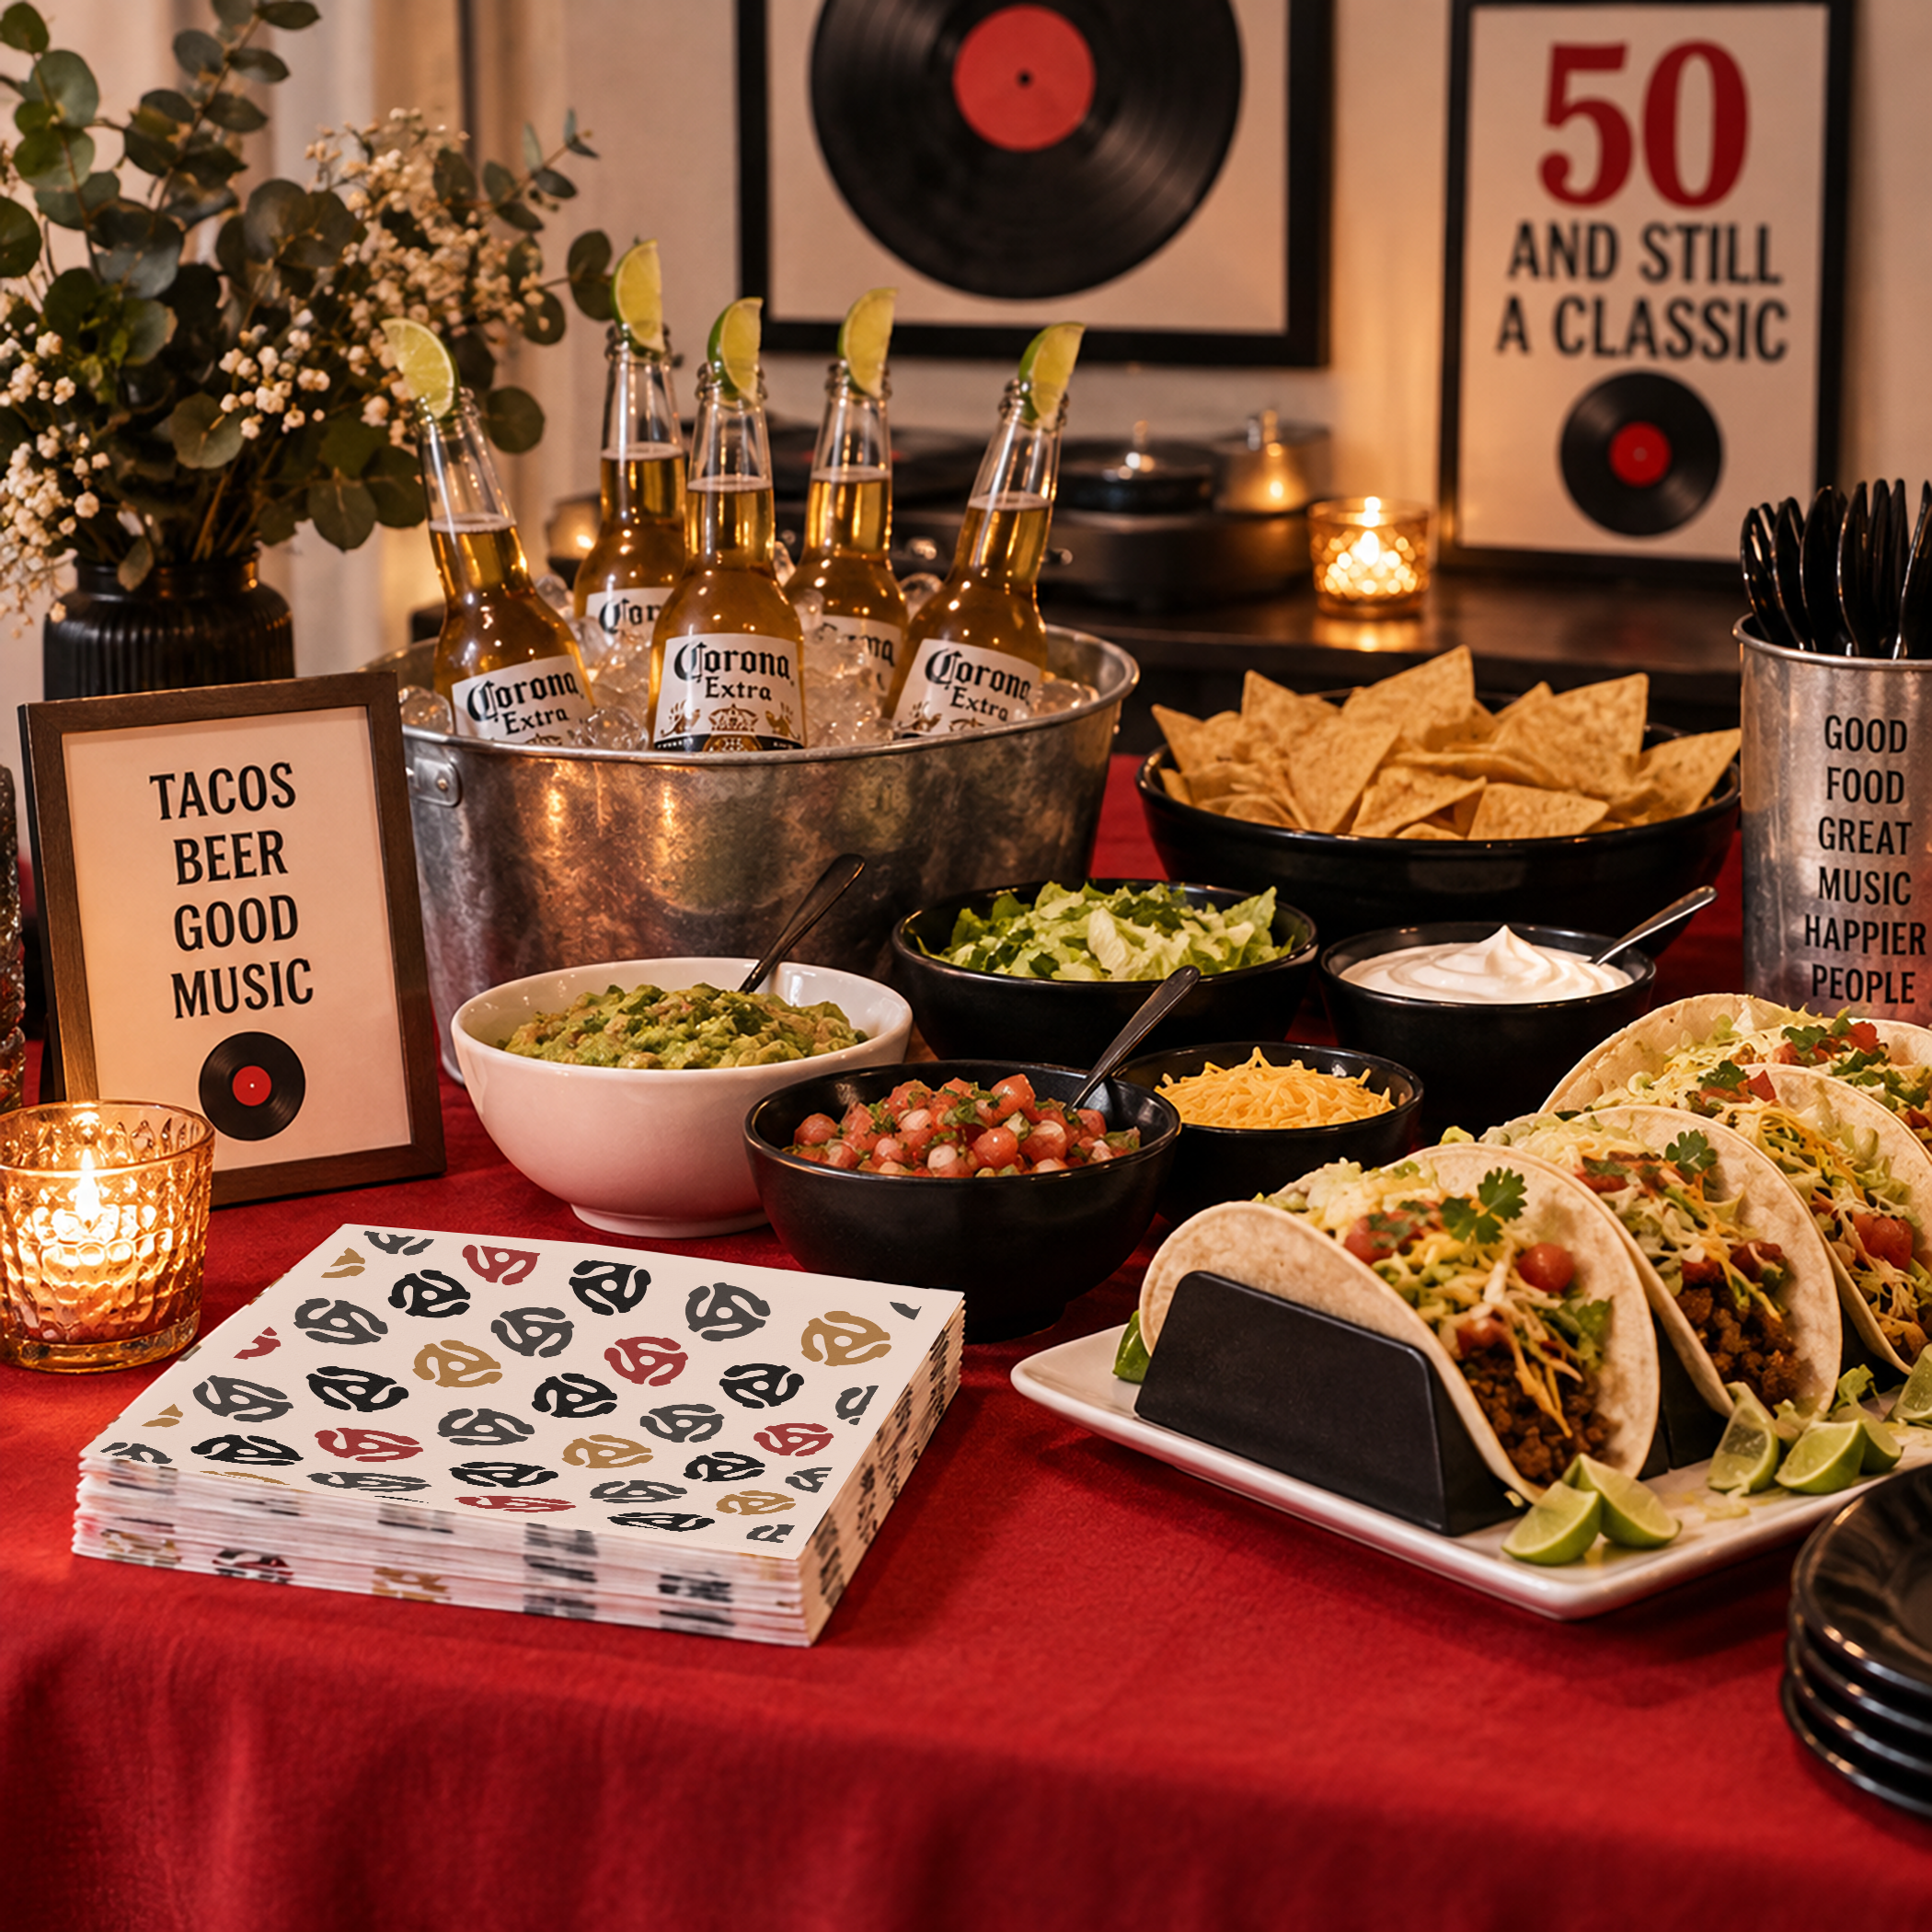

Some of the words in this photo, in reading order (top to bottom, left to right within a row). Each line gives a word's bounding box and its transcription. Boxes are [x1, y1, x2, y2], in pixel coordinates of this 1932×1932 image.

[1537, 39, 1751, 211] 50
[1506, 220, 1620, 282] AND
[1639, 222, 1784, 285] STILL
[1496, 294, 1531, 357] A
[1553, 295, 1788, 363] CLASSIC
[599, 598, 662, 635] Cor
[674, 642, 793, 684] Corona
[925, 648, 1032, 706] Corona
[467, 673, 581, 723] Corona
[705, 676, 772, 701] Extra
[950, 686, 1008, 722] Extra
[501, 707, 569, 735] Extra
[1824, 715, 1907, 753] GOOD
[149, 761, 296, 820] TACOS
[1826, 766, 1904, 804] FOOD
[1818, 816, 1913, 855] GREAT
[173, 830, 288, 885] BEER
[1818, 867, 1912, 905] MUSIC
[173, 894, 298, 951] GOOD
[1804, 914, 1926, 955] HAPPIER
[170, 958, 314, 1019] MUSIC
[1811, 964, 1915, 1004] PEOPLE
